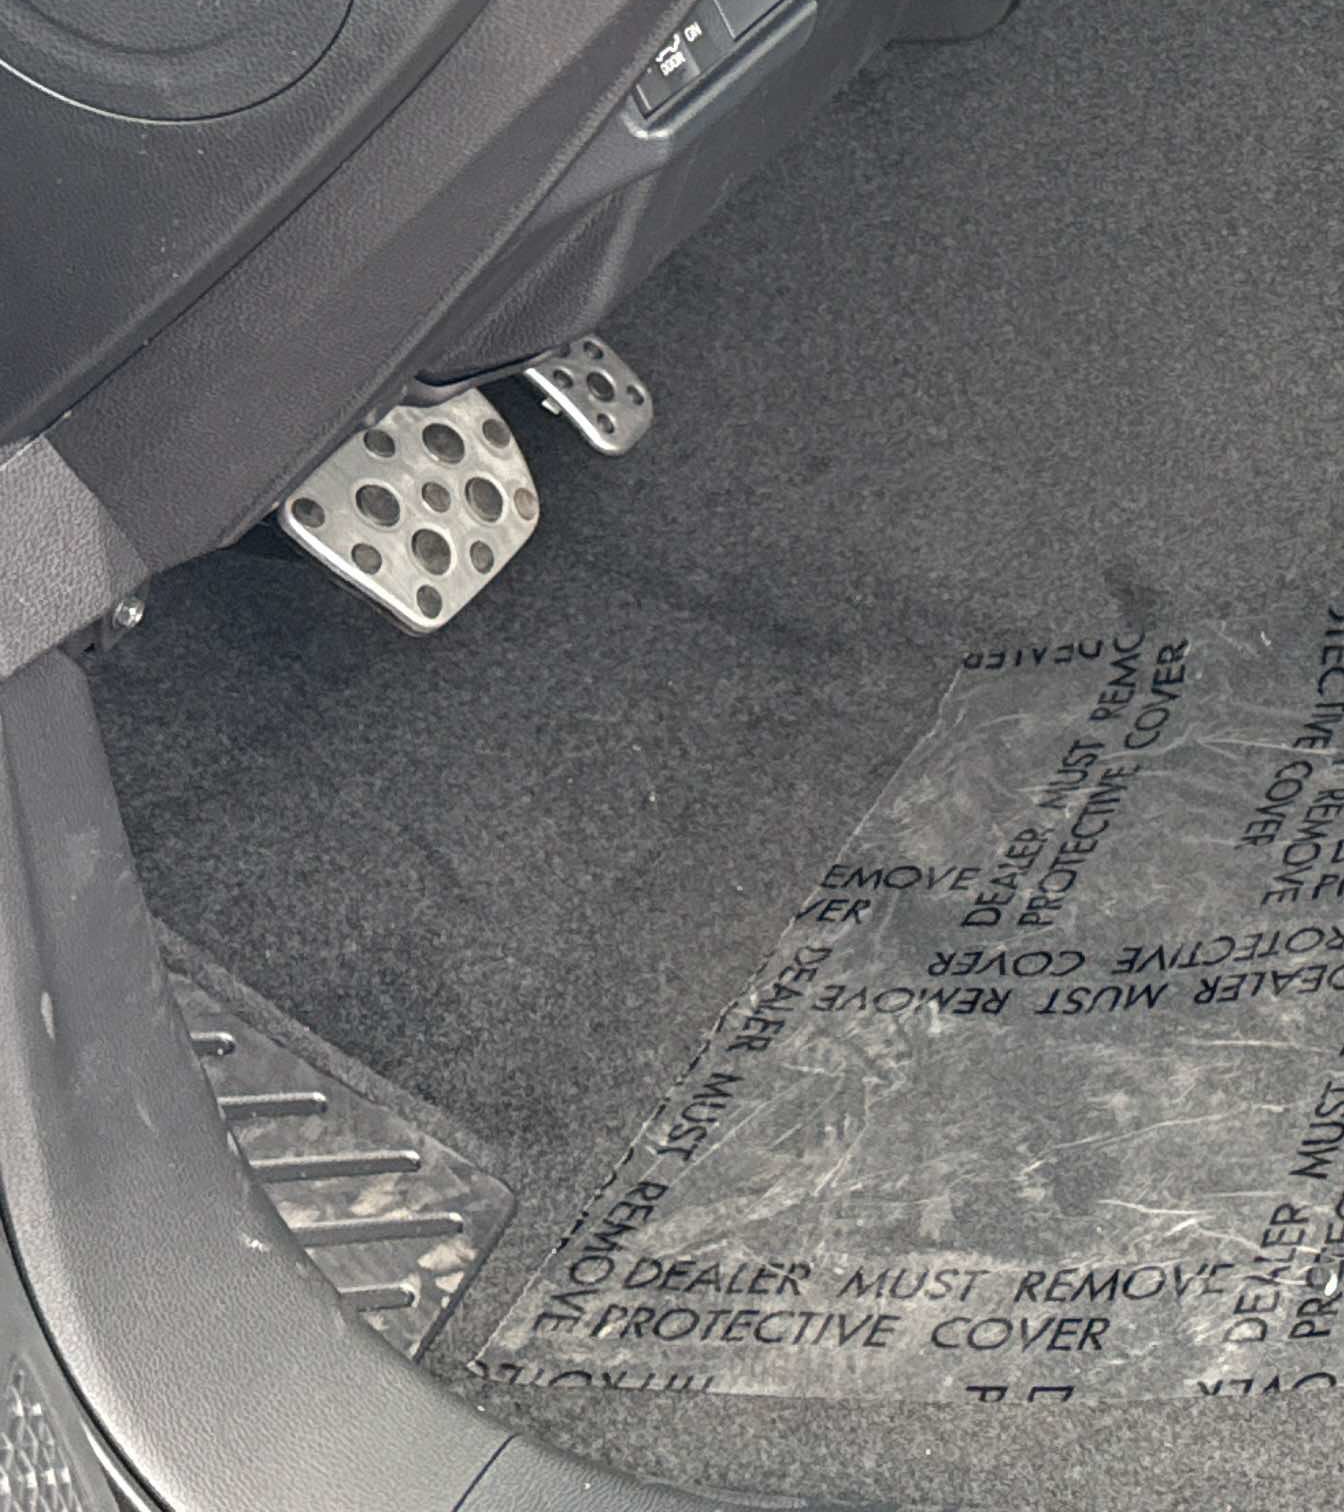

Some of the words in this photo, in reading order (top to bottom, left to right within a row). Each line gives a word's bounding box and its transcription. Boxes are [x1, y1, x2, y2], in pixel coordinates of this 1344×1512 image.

[660, 51, 686, 76] DOOR
[684, 21, 702, 42] ON
[1018, 763, 1142, 928] PROTECTIVE
[1125, 637, 1189, 750] COVER
[1235, 761, 1312, 850] COVER
[961, 827, 1053, 928] DEALER
[1039, 739, 1104, 809] MUST
[727, 945, 832, 1053] DEALER
[927, 951, 1086, 978] COVER
[1035, 983, 1169, 1015] MUST
[812, 984, 1012, 1015] REMOVE
[657, 1072, 744, 1163] MUST
[533, 1180, 669, 1333] REMOVE
[625, 1257, 811, 1296] DEALER
[837, 1268, 991, 1302] MUST
[1013, 1262, 1234, 1304] REMOVE
[1223, 1202, 1309, 1343] DEALER
[589, 1304, 902, 1350] PROTECTIVE
[931, 1316, 1111, 1353] COVER
